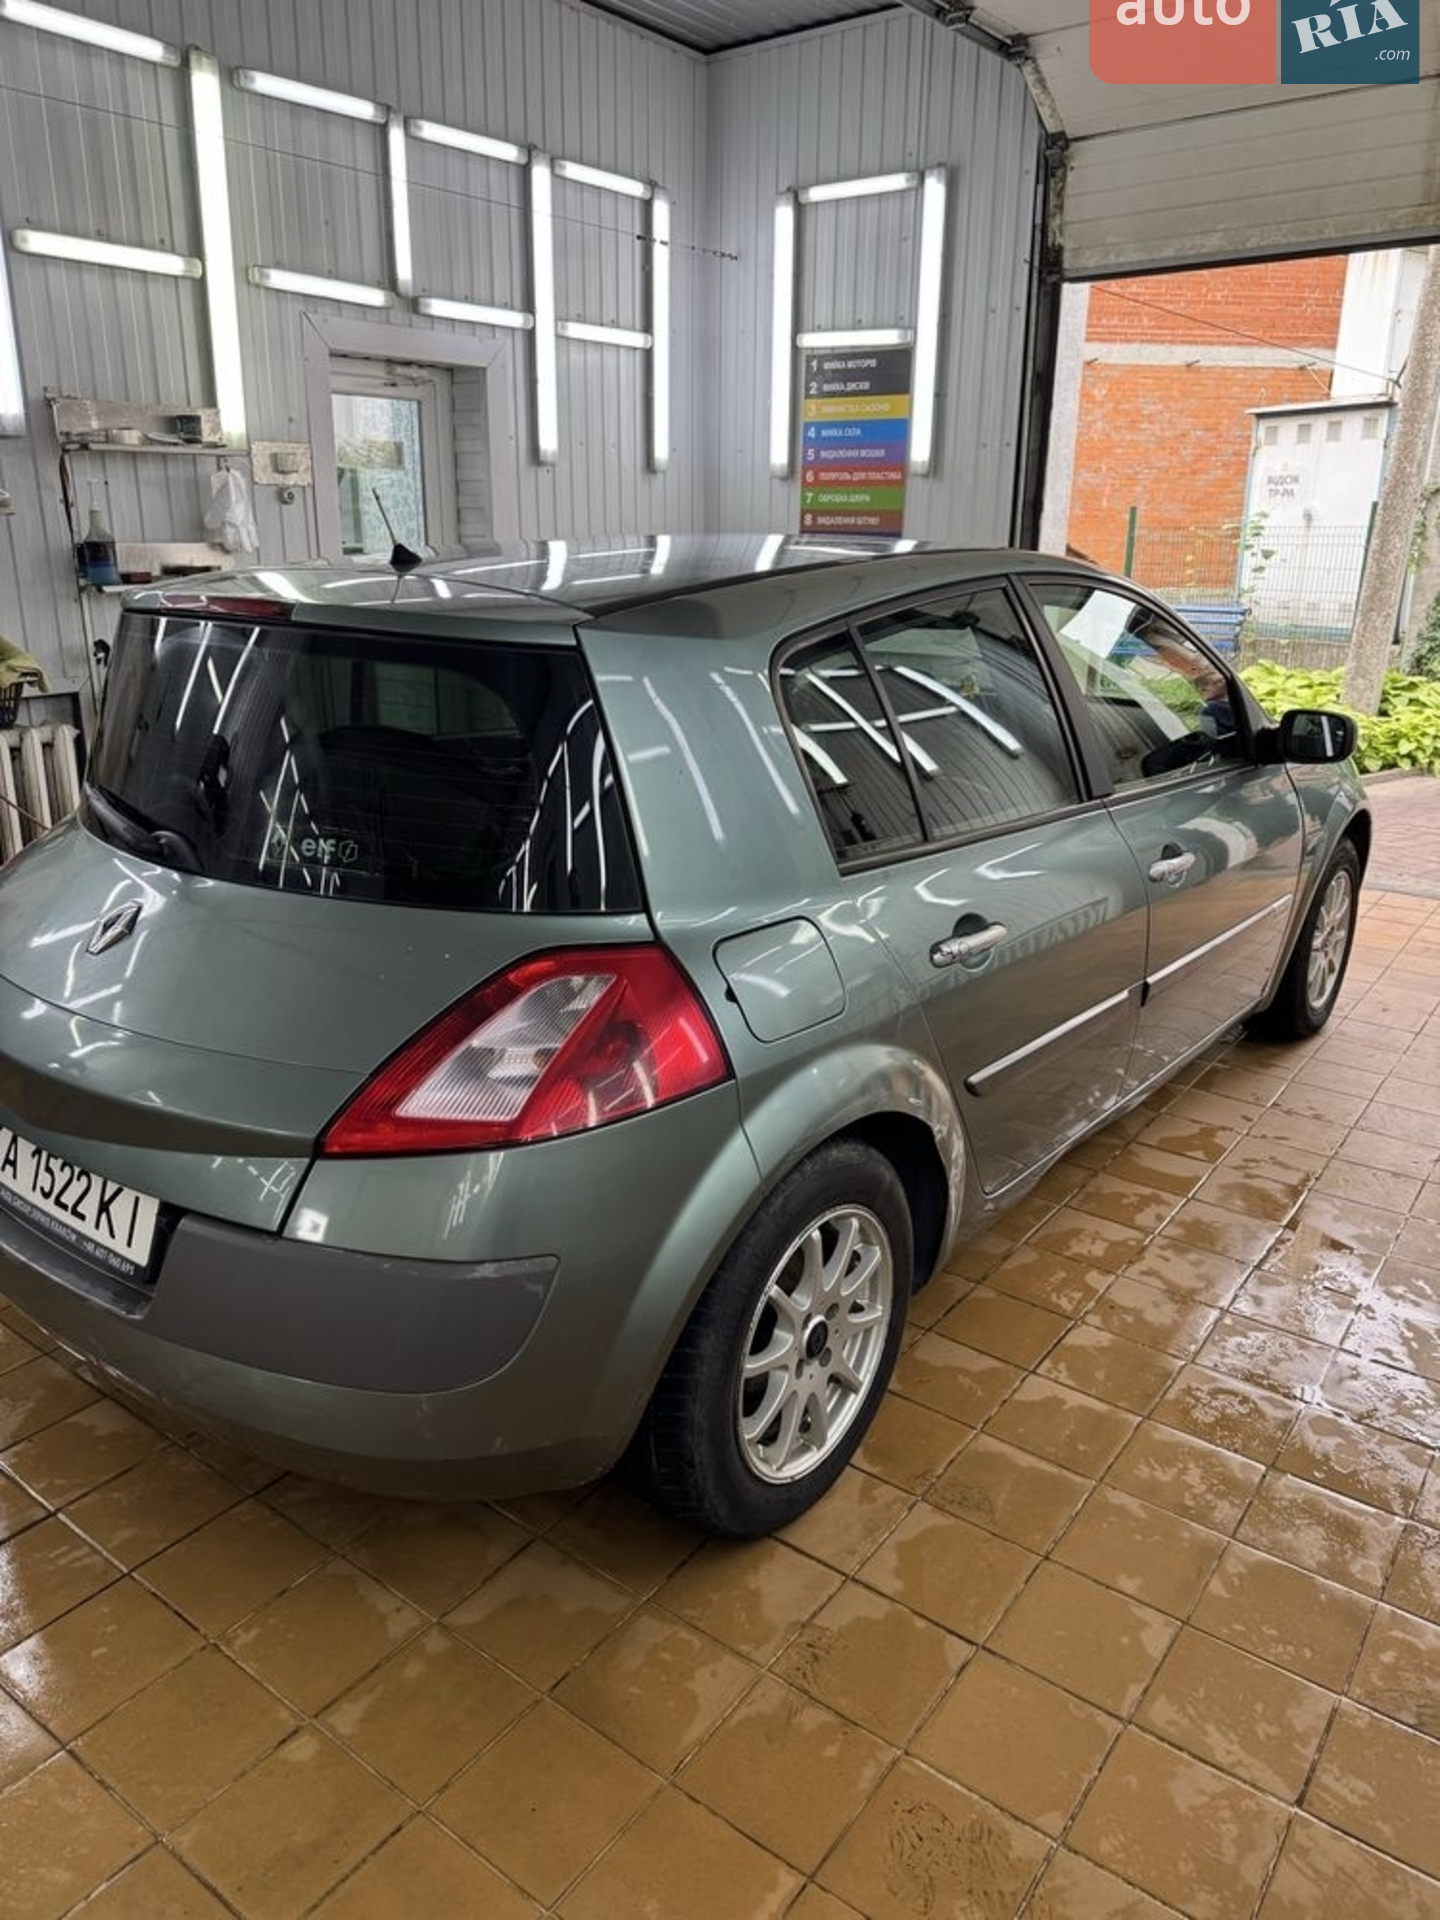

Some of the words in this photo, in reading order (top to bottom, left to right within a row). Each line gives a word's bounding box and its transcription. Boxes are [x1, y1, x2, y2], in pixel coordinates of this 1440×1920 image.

[810, 359, 817, 371] 1
[810, 382, 818, 394] 2
[808, 403, 817, 417] 3
[807, 426, 816, 438] 4
[806, 448, 815, 461] 5
[819, 449, 859, 459] ВИДАЛЕННЯ
[805, 470, 815, 482] 6
[805, 492, 813, 504] 7
[804, 513, 813, 525] 8
[31, 1147, 92, 1222] 1522
[95, 1179, 140, 1249] KI
